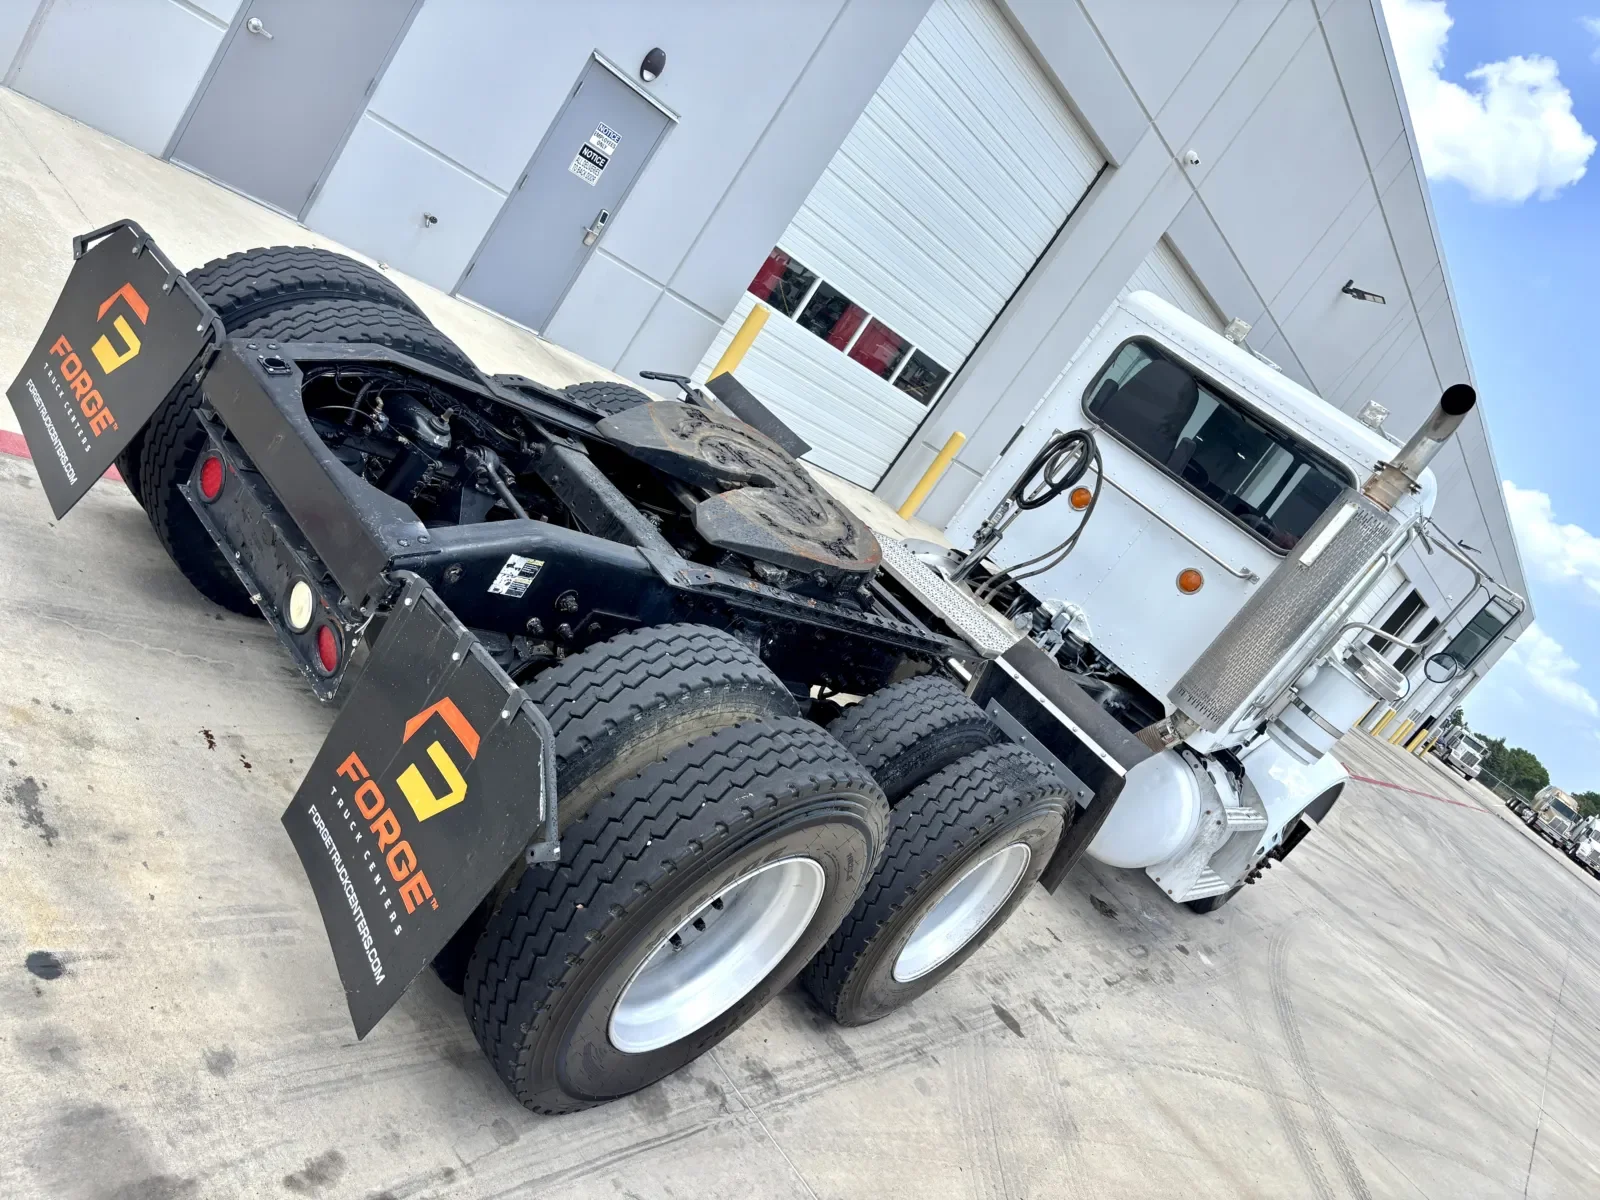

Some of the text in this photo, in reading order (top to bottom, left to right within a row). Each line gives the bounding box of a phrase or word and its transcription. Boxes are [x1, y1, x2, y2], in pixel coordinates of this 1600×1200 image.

[594, 131, 616, 149] EMPLOYEES
[598, 124, 620, 143] NOTICE
[596, 140, 607, 150] ONLY
[582, 147, 605, 166] NOTICE
[577, 166, 587, 177] BACK
[582, 160, 600, 176] DELIVERIES
[43, 362, 92, 453] TRUCK CENTERS
[26, 378, 78, 486] FORGETRUCKCENTERS.COM
[330, 786, 402, 937] TRUCK CENTERS
[308, 804, 386, 985] FORGETRUCKCENTERS.COM
